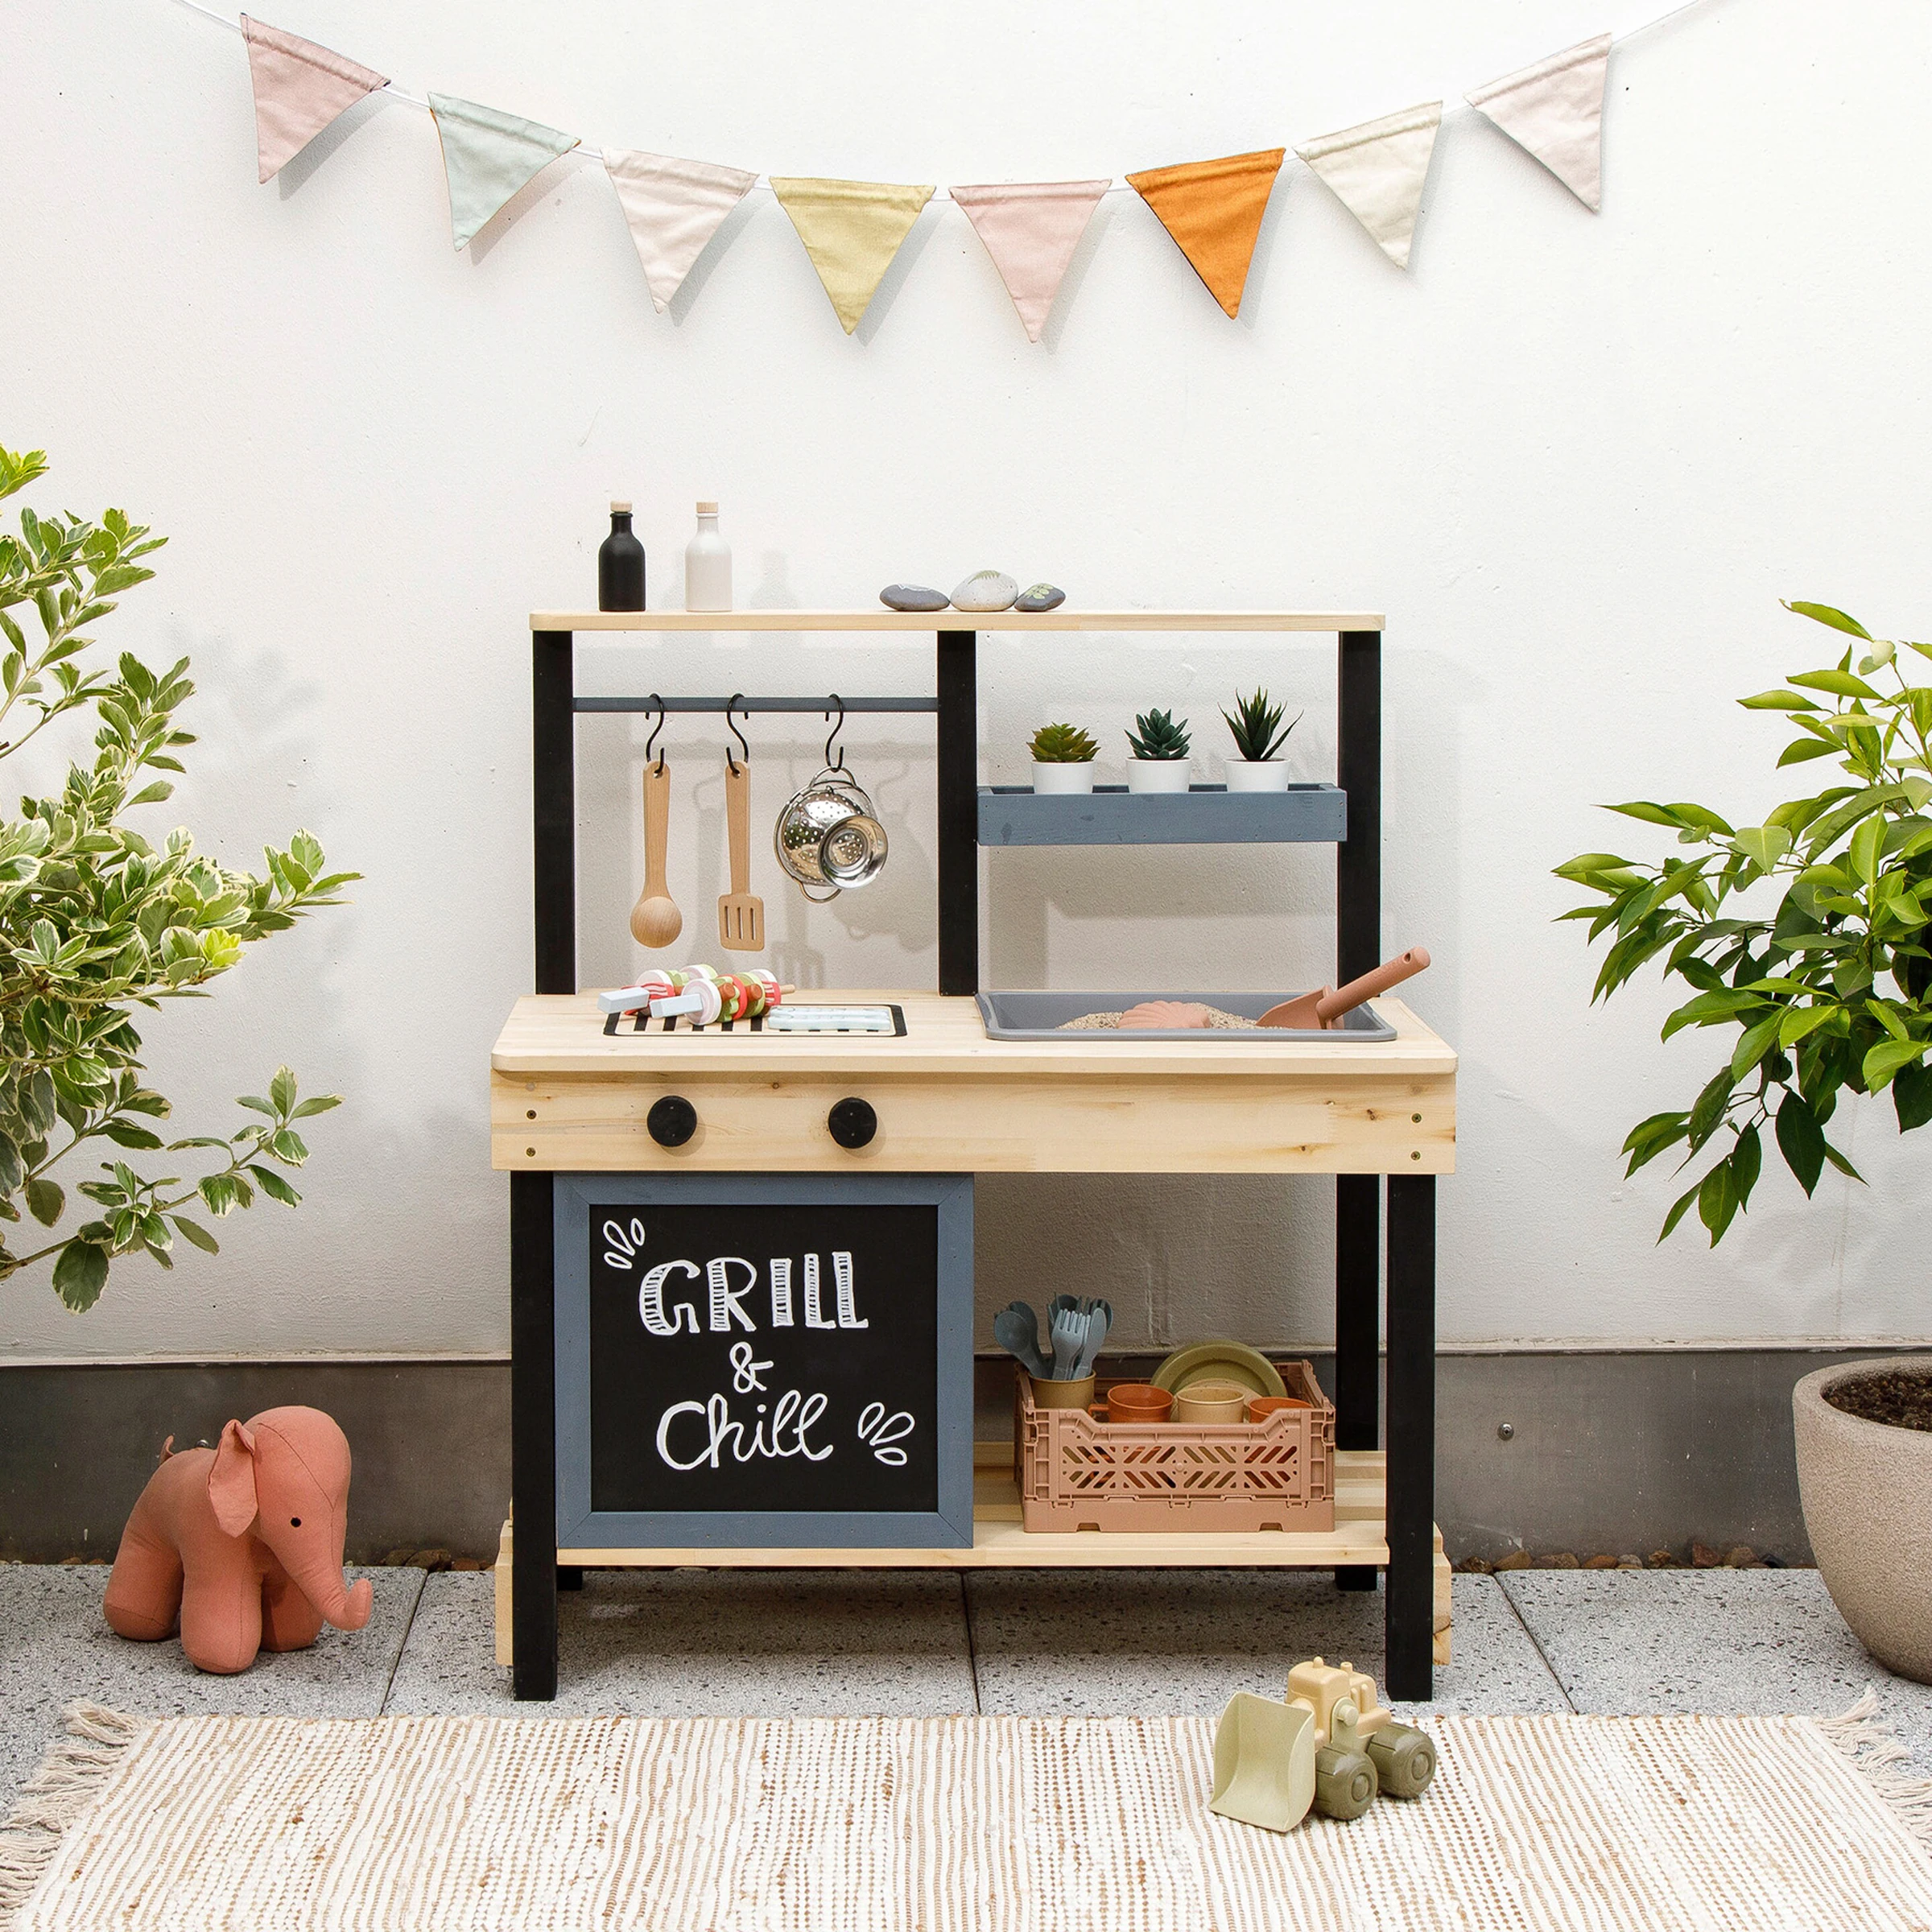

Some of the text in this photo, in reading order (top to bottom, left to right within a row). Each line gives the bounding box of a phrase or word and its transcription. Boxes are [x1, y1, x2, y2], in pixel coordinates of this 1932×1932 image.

[639, 1251, 869, 1335] GRILL
[729, 1341, 774, 1393] &
[657, 1390, 833, 1470] Chill
